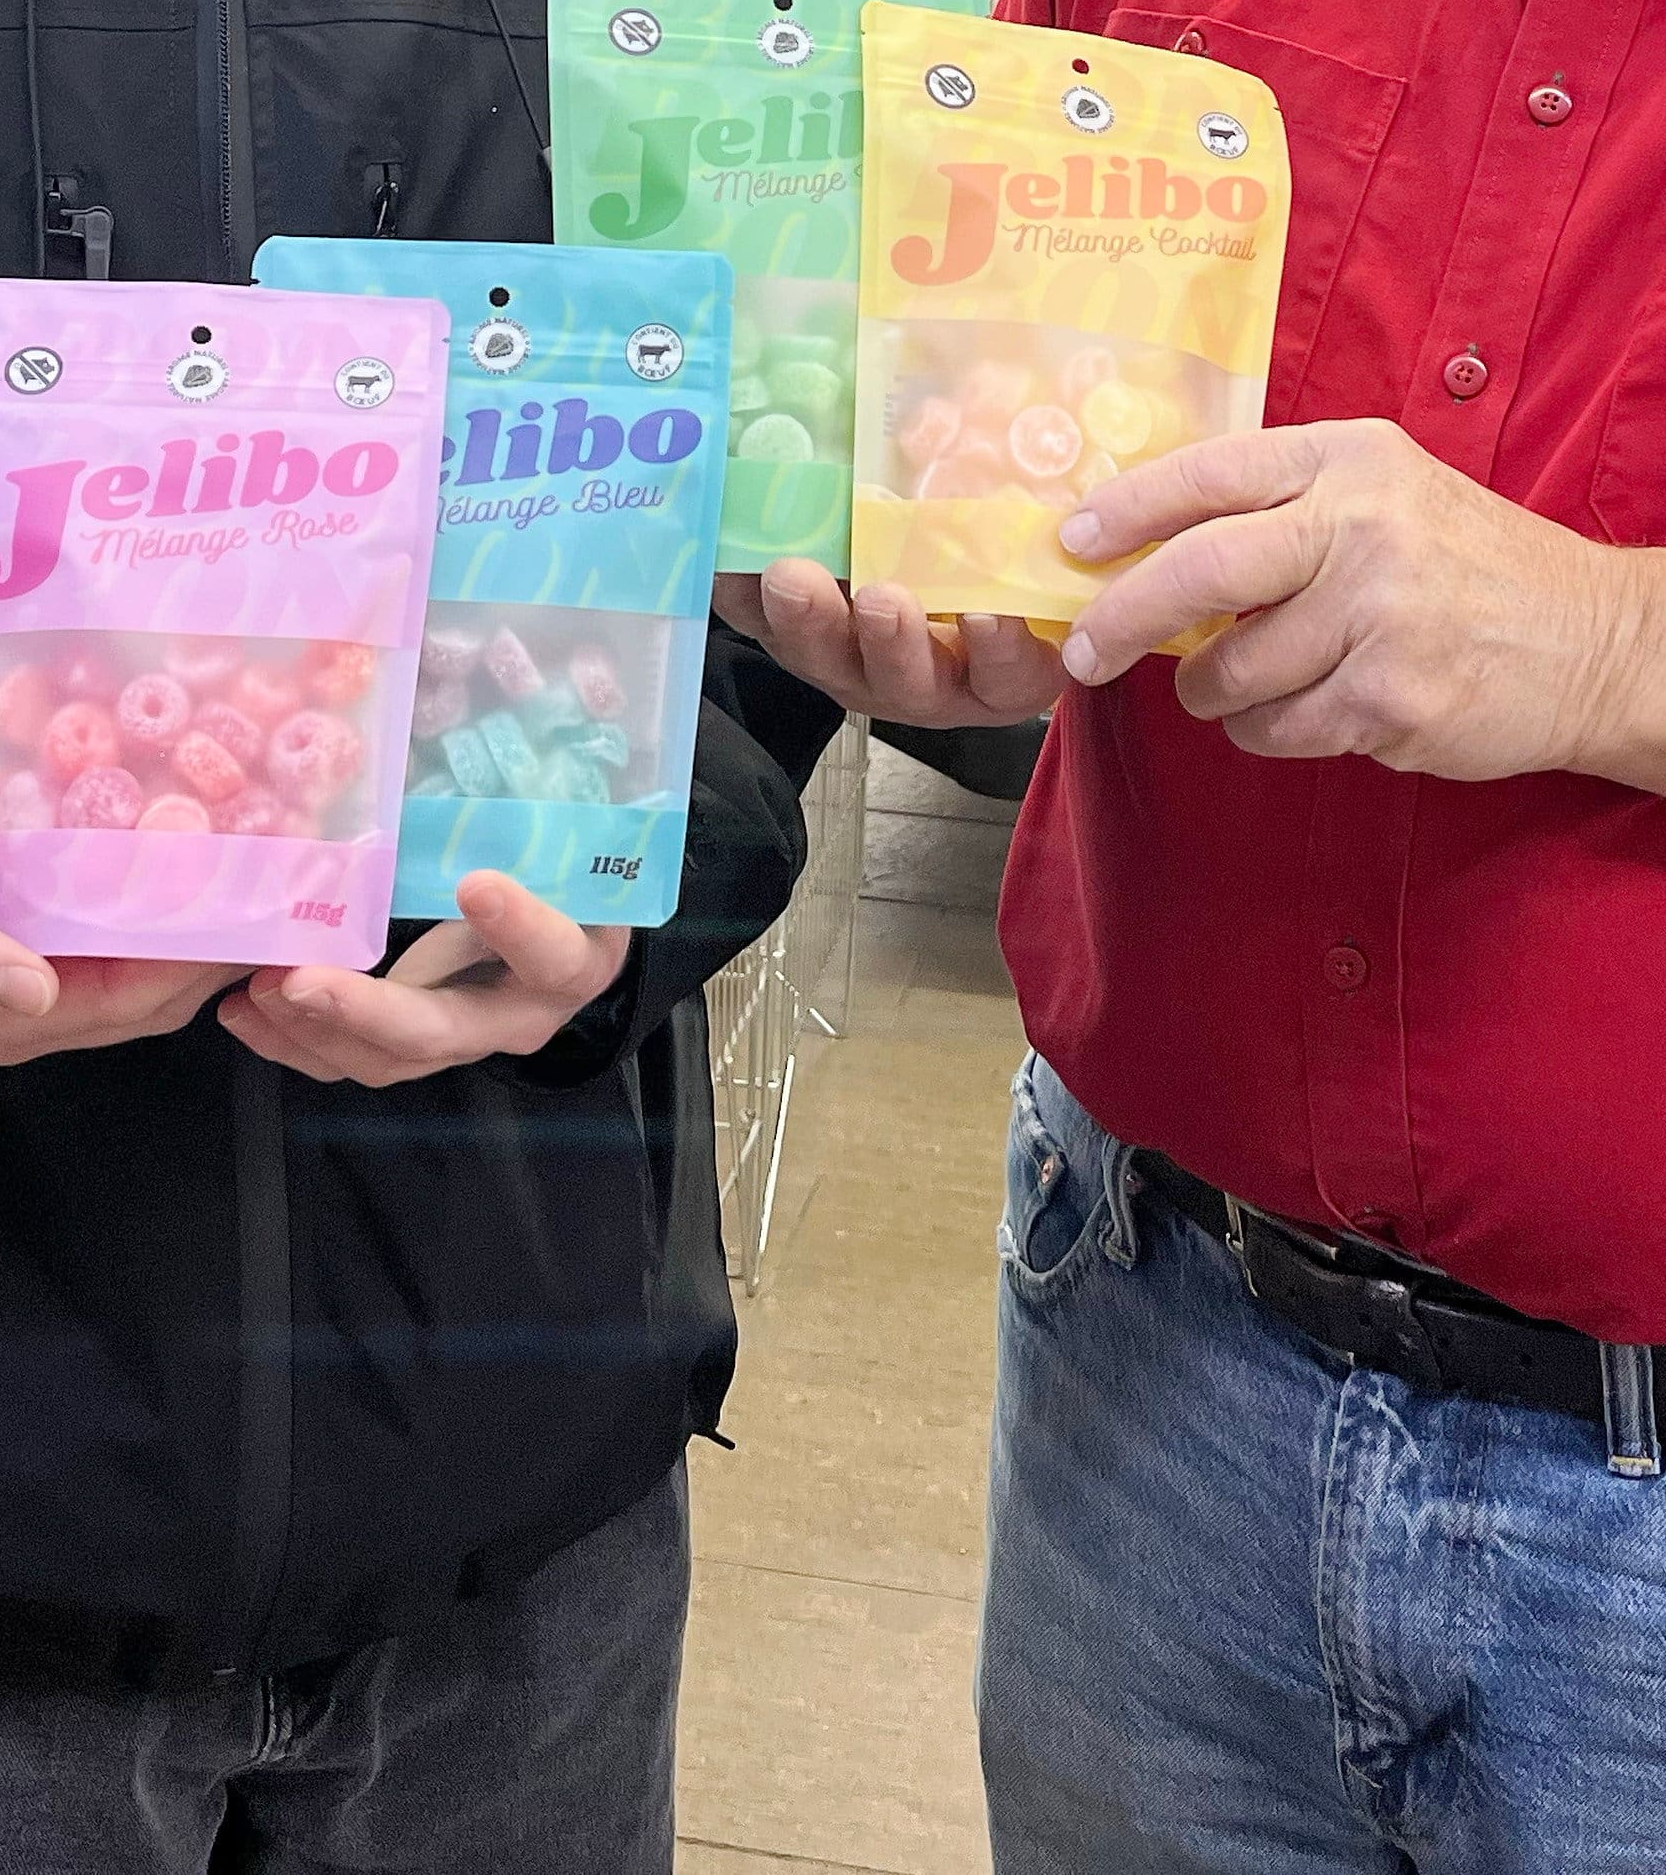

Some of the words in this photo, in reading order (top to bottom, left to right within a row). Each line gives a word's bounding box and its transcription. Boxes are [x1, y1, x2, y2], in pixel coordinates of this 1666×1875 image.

[701, 170, 849, 206] Mélange
[890, 155, 1269, 286] Jelibo
[1002, 223, 1144, 263] Mélange
[1148, 226, 1258, 261] Cocktail
[440, 398, 703, 486] libo
[572, 478, 665, 515] Bleu
[80, 524, 250, 570] Mélange
[262, 509, 359, 550] Rose
[589, 855, 643, 880] 115g
[289, 900, 348, 928] 115g
